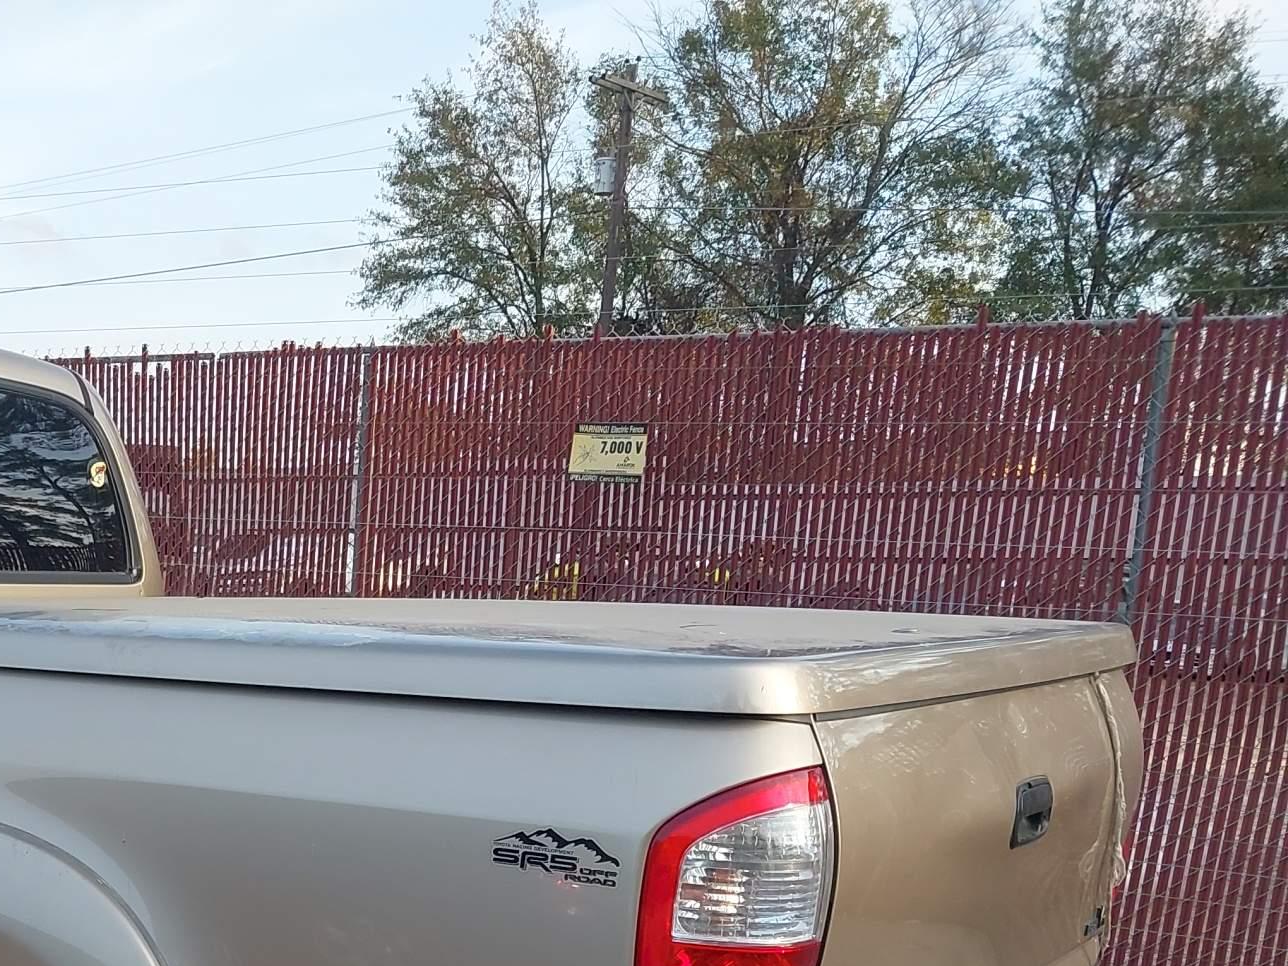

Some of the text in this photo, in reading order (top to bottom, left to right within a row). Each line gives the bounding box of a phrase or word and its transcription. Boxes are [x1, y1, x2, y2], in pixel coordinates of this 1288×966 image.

[578, 424, 645, 434] WARNING! Electric Fence
[600, 441, 644, 455] 7,000 V
[512, 843, 533, 851] RACING
[533, 845, 575, 856] DEVELOPMENT
[492, 847, 618, 878] SR5 OFF
[564, 873, 617, 888] ROAD
